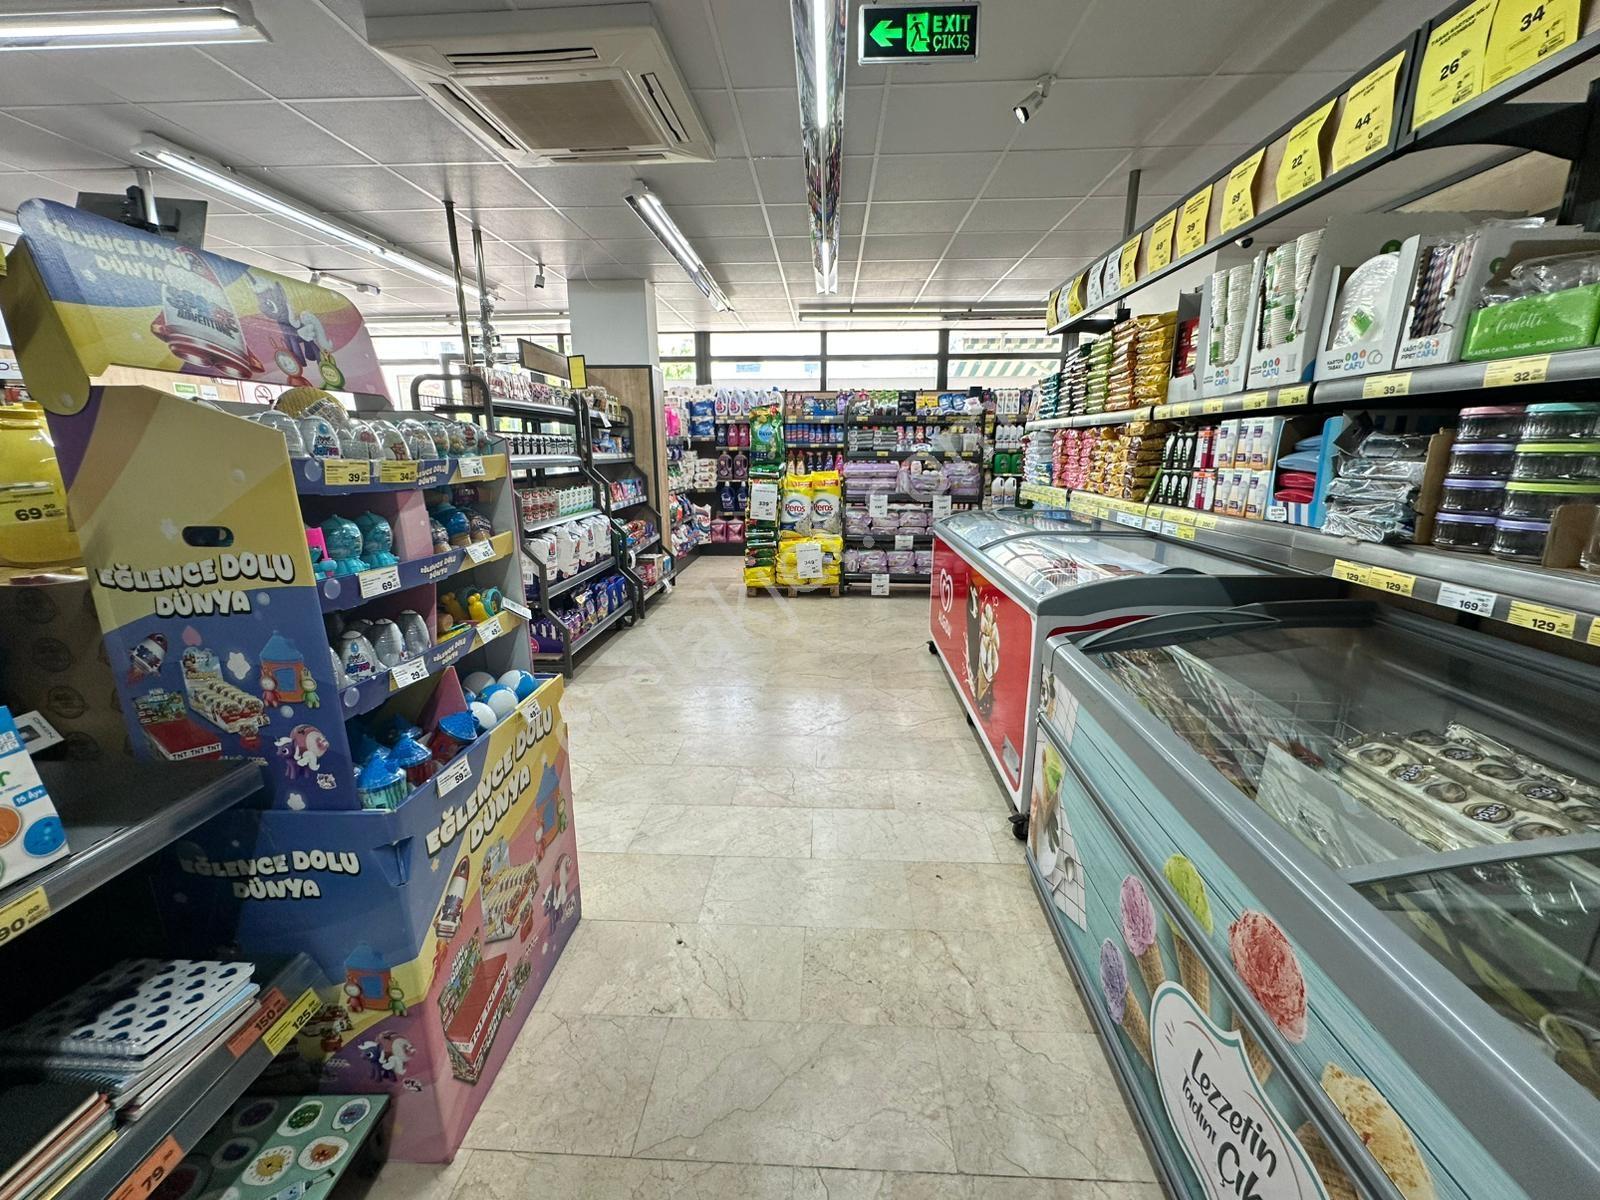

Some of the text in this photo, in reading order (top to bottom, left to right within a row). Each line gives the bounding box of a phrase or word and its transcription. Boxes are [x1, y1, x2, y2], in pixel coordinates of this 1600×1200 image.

[933, 14, 971, 32] EXIT
[1520, 5, 1546, 32] 34
[932, 34, 970, 52] ÇIKIŞ
[1440, 58, 1460, 82] 26
[1355, 112, 1371, 129] 44
[1291, 155, 1303, 170] 22
[39, 218, 192, 272] EĞLENCE DOLU
[94, 252, 168, 283] DÜNYA
[1417, 348, 1439, 359] CAFU
[1262, 367, 1280, 378] CAFU
[1344, 360, 1365, 371] CAFU
[1513, 371, 1530, 382] 32
[1383, 386, 1396, 395] 39
[348, 473, 360, 482] 39
[400, 472, 409, 481] 34
[15, 507, 43, 522] 69
[784, 503, 805, 513] Peros
[814, 502, 833, 512] Peros
[97, 552, 295, 592] EĞLENCE DOLU
[1346, 572, 1359, 582] 129
[382, 581, 393, 591] 69
[1386, 581, 1400, 592] 129
[154, 588, 251, 618] DÜNYA
[1459, 599, 1479, 612] 169
[1532, 618, 1556, 632] 129
[172, 743, 221, 760] TNT TNT TNT
[425, 705, 554, 860] EĞLENCE DOLU
[455, 772, 464, 784] 59
[469, 764, 532, 855] DÜNYA
[180, 850, 361, 878] EĞLENCE DOLU
[232, 877, 321, 900] DÜNYA
[254, 1008, 276, 1031] 150
[292, 1009, 311, 1030] 125
[1182, 1067, 1217, 1145] Tadını
[1191, 1048, 1277, 1178] Lezzetin
[140, 1165, 164, 1192] 79
